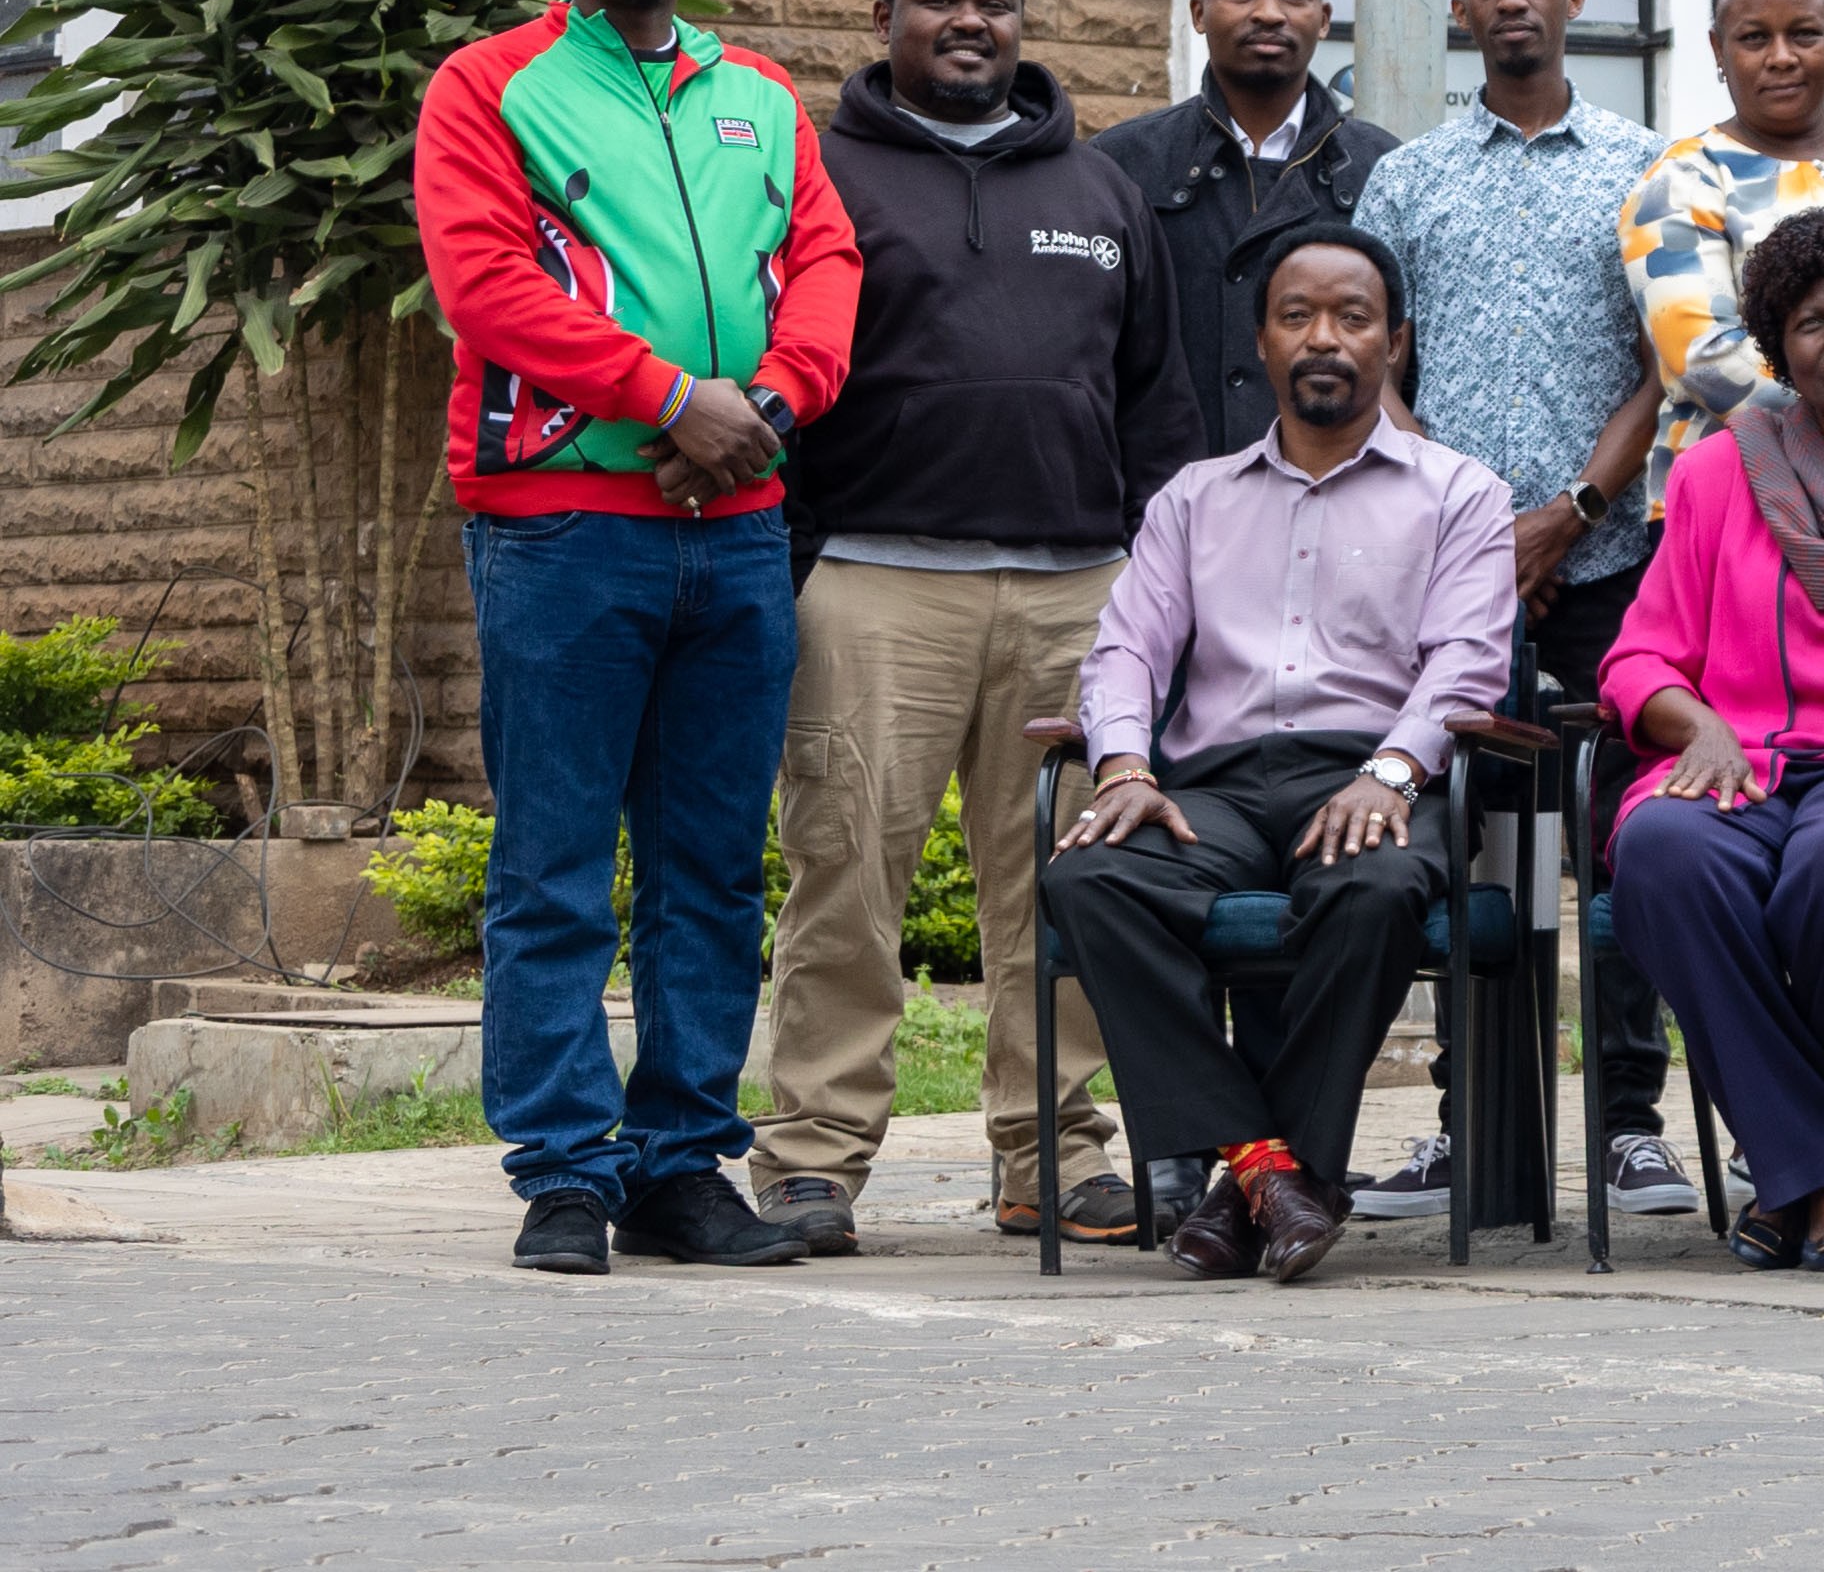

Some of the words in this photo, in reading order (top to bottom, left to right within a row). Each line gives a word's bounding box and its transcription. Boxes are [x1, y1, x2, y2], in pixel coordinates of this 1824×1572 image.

[1030, 230, 1049, 244] St
[1052, 229, 1089, 248] John
[1032, 243, 1090, 258] Ambulance
